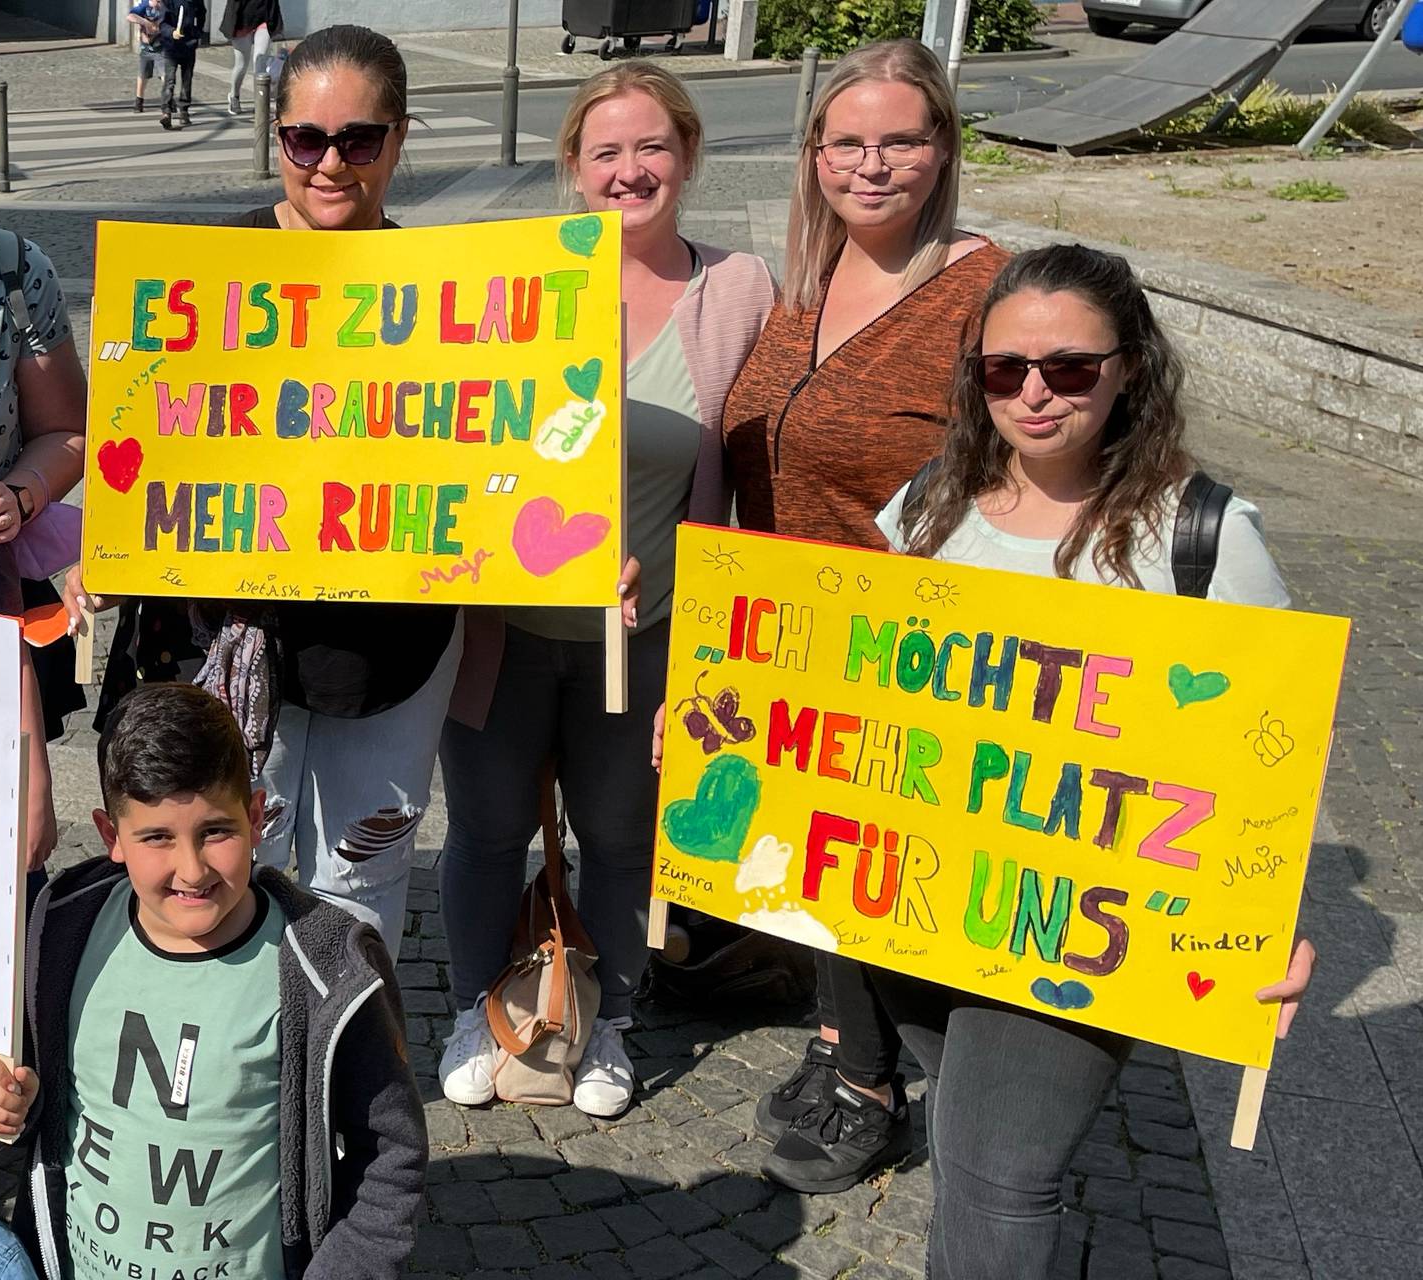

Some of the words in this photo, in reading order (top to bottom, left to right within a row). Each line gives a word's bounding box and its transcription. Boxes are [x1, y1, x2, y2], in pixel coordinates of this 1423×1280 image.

[223, 281, 321, 351] IST
[337, 283, 419, 347] ZU
[439, 269, 589, 344] LAUT
[154, 380, 262, 437] WIR
[276, 379, 536, 446] BRAUCHEN
[143, 481, 290, 553] MEHR
[313, 586, 370, 601] Zümra
[419, 548, 494, 594] Maja
[844, 615, 1134, 738] MÖCHTE
[766, 699, 942, 806] MEHR
[966, 740, 1216, 871] PLATZ
[659, 857, 713, 893] Zümra
[801, 810, 940, 933] FÜR
[1221, 855, 1287, 887] Maja
[885, 938, 927, 956] Mariam
[1170, 932, 1273, 952] Kinder
